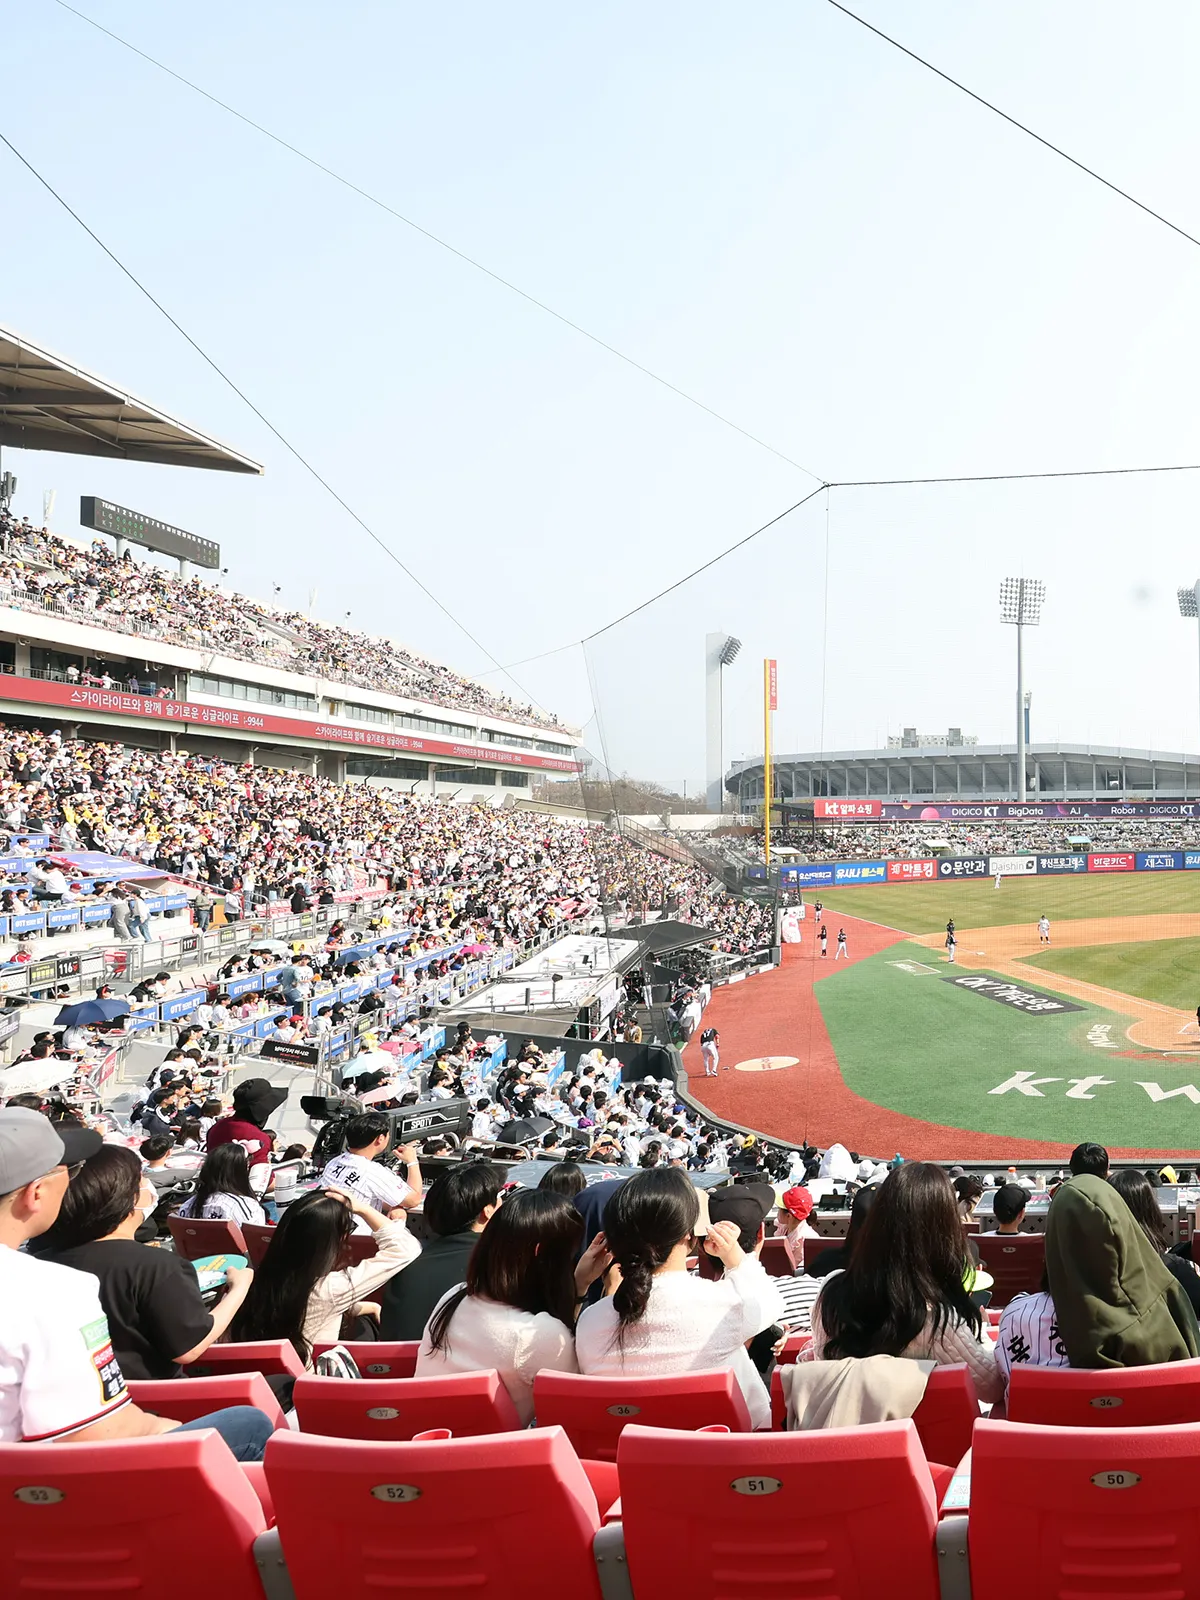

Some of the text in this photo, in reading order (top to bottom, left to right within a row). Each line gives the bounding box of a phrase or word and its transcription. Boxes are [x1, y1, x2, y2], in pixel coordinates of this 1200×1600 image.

[101, 502, 116, 512] TEAM
[71, 690, 239, 724] 스카이라이프와 함께 슬기로운 싱글라이프
[825, 802, 838, 814] kt
[840, 804, 856, 814] 알파
[857, 804, 872, 814] 쇼핑
[984, 807, 999, 816] KT
[1009, 808, 1043, 817] BigData
[1180, 805, 1194, 814] KT
[953, 861, 985, 875] 문안과
[992, 861, 1024, 871] Daishin
[1041, 857, 1084, 869] 광신프로그레스
[1144, 859, 1174, 868] 제스파
[836, 868, 860, 878] 유사나
[903, 862, 933, 877] 마트킹
[183, 940, 192, 950] 117
[59, 964, 72, 975] 116
[1086, 1024, 1119, 1048] SHOW
[988, 1071, 1116, 1100] kt
[411, 1117, 432, 1129] SPOTV
[1107, 1475, 1124, 1484] 50
[748, 1481, 764, 1491] 51
[30, 1490, 48, 1500] 53
[388, 1488, 405, 1498] 52
